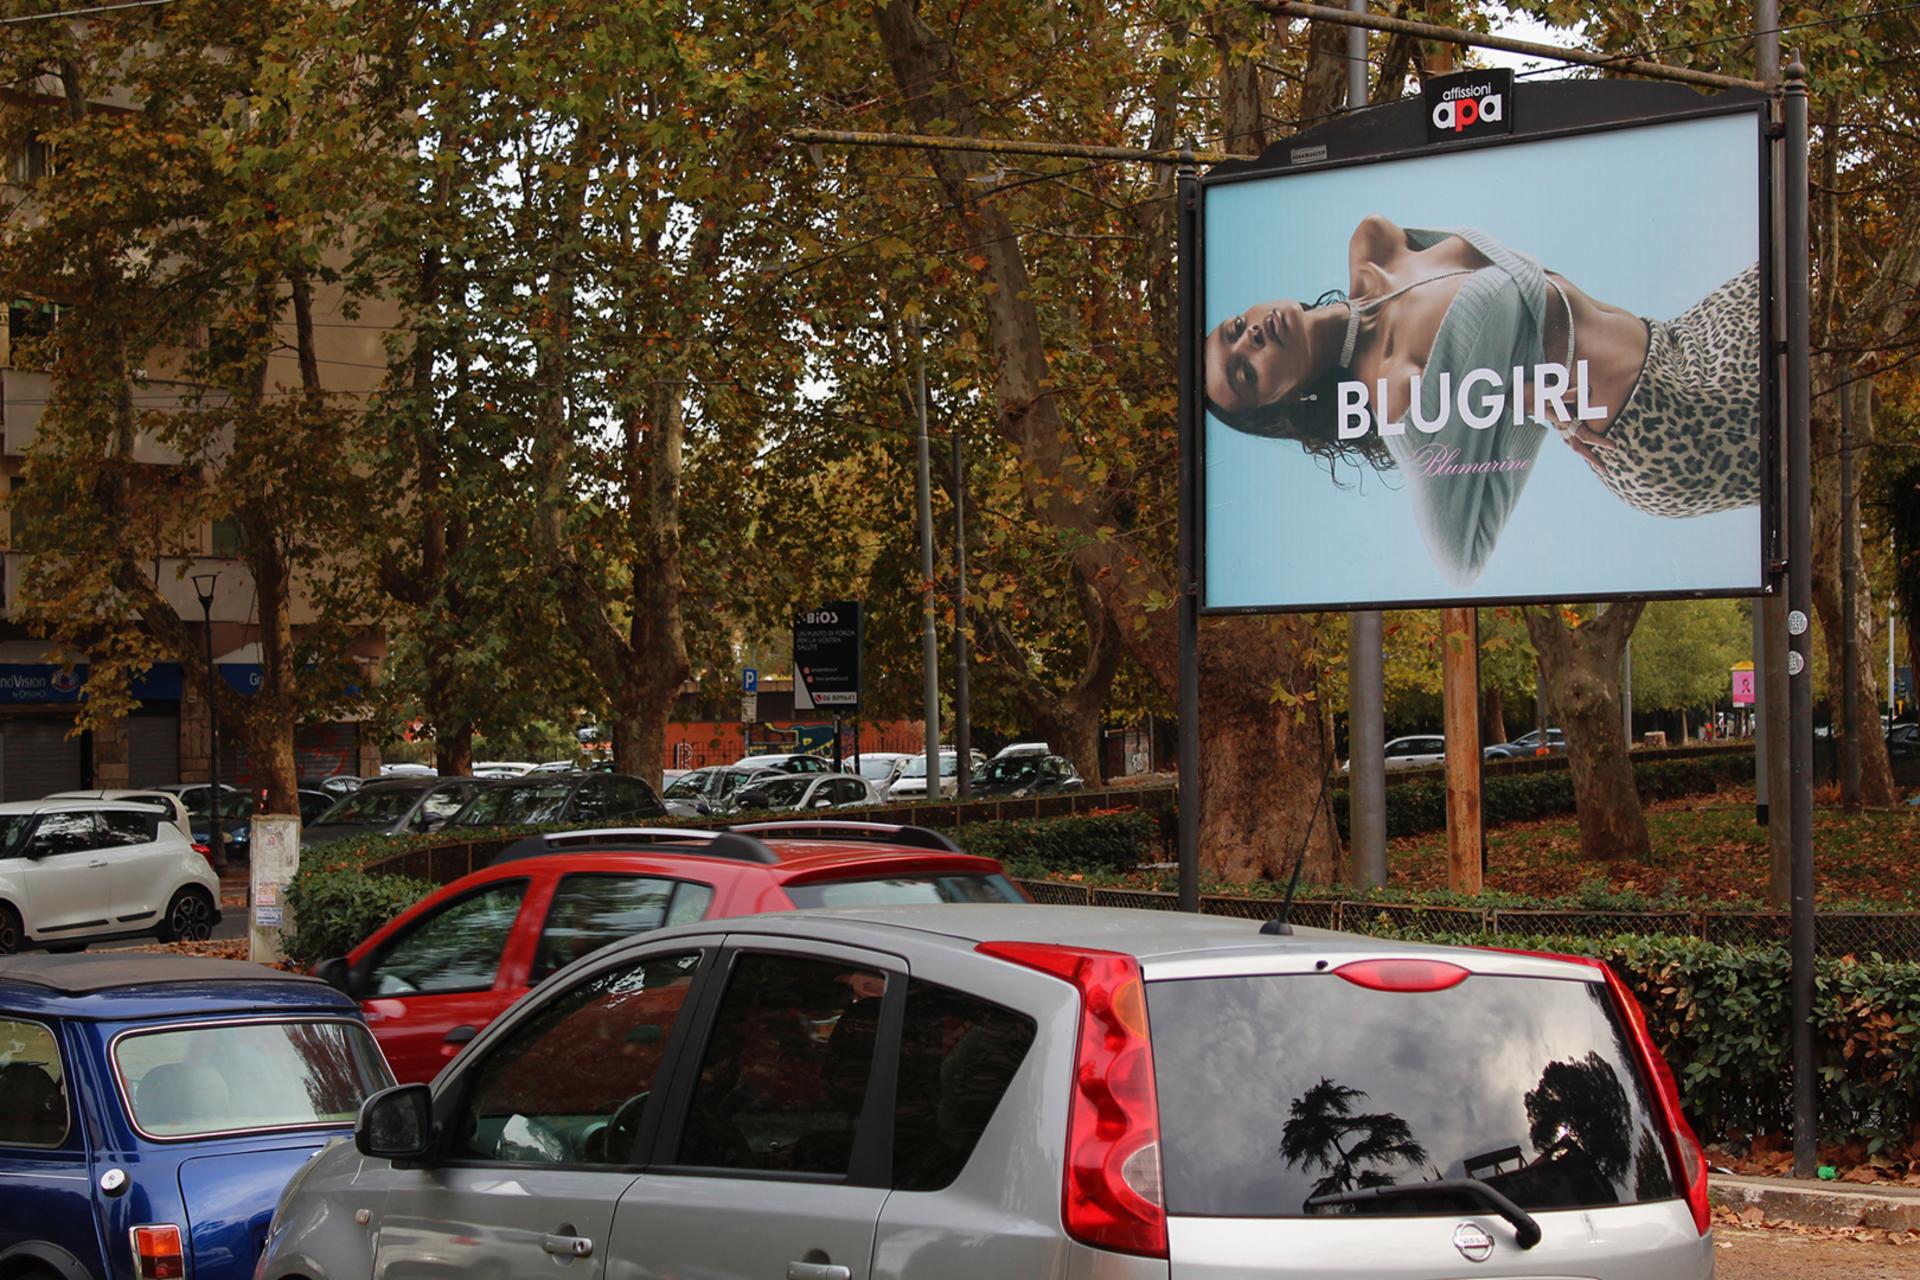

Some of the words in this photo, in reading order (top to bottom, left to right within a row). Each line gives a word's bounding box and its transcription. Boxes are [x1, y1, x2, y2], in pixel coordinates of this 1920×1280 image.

[1442, 82, 1492, 101] affissioni
[1432, 93, 1503, 133] apa
[1337, 359, 1608, 440] BLUGIRL
[1408, 442, 1534, 478] Blumarine
[745, 671, 755, 689] P
